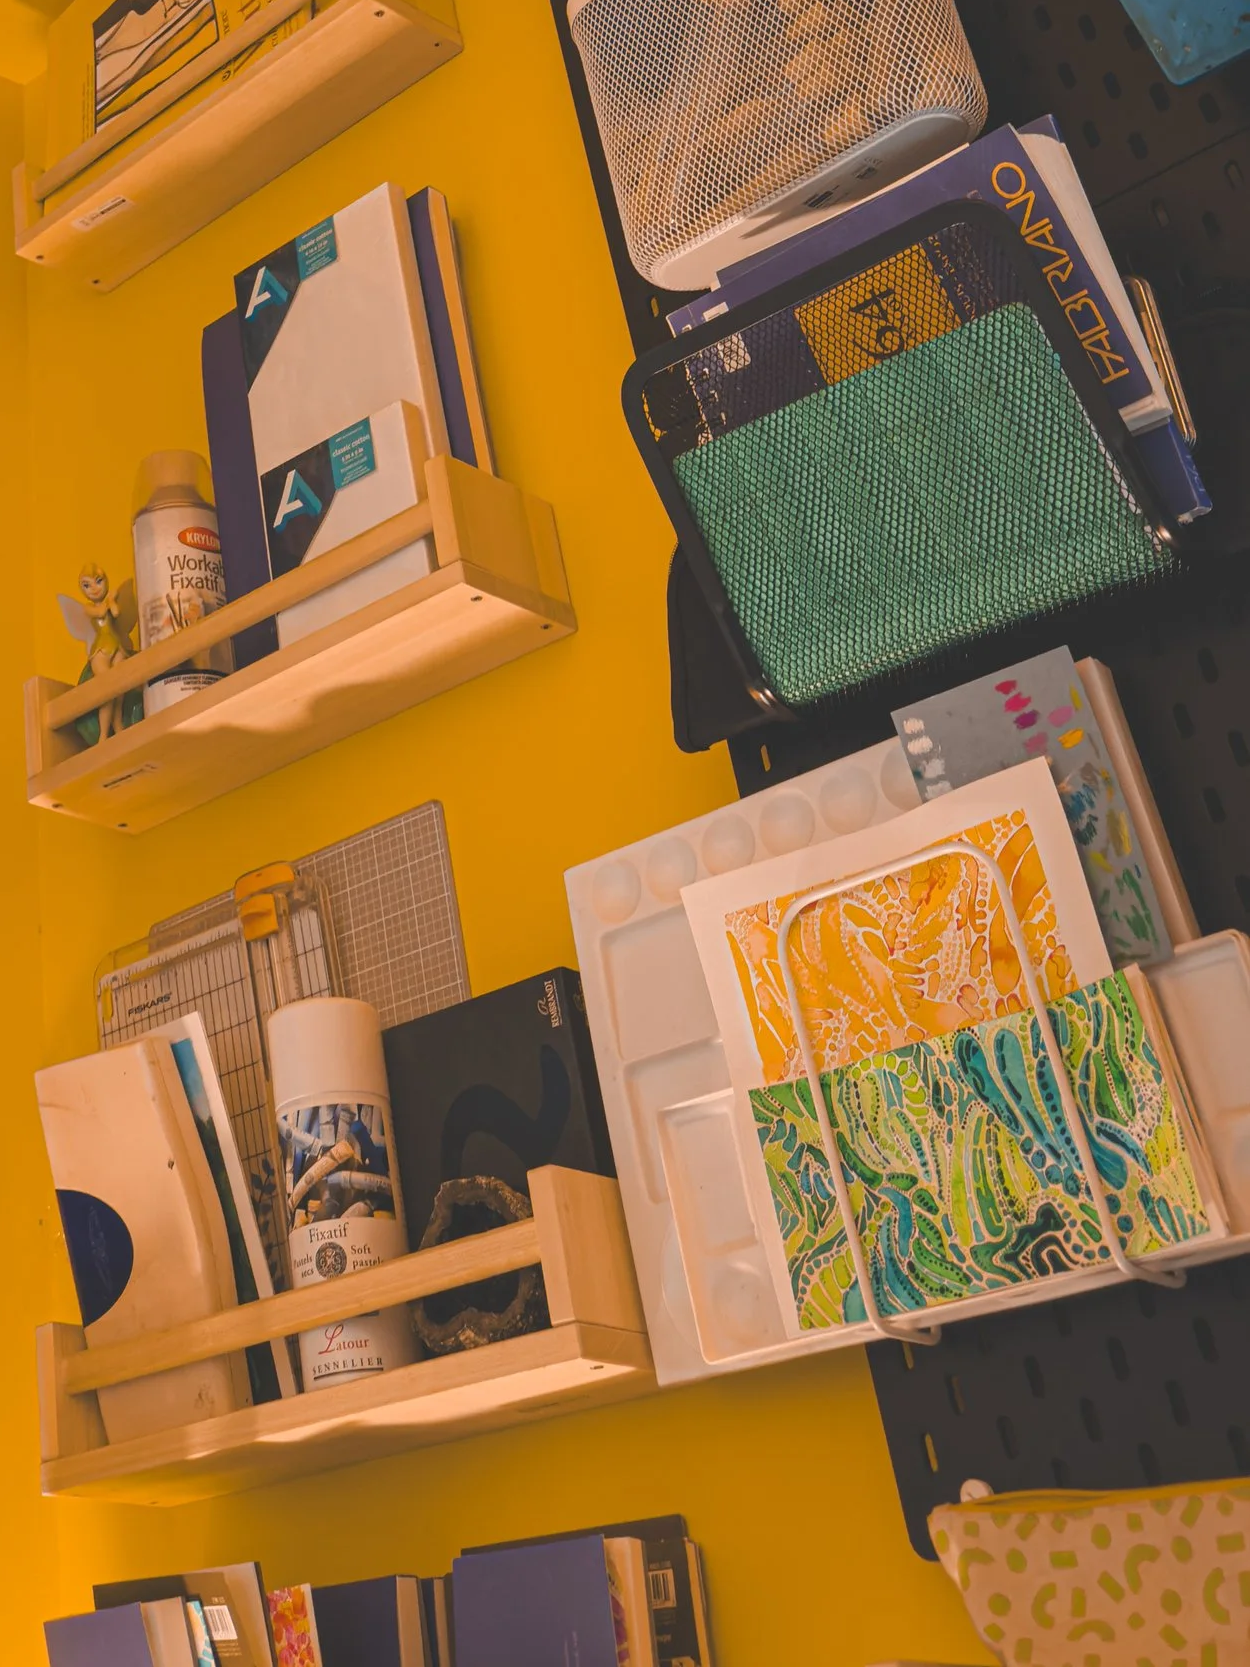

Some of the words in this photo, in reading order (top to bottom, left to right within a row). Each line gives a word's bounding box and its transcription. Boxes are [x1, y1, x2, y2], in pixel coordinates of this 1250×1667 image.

[991, 161, 1130, 384] FABRIANO
[167, 554, 225, 578] Workab
[170, 572, 219, 592] Fixatif
[128, 994, 171, 1017] FISKARS
[544, 980, 559, 1028] REMBRANDT
[308, 1222, 350, 1244] Fixatif
[350, 1245, 371, 1256] Soft
[352, 1255, 384, 1270] pastel
[318, 1323, 370, 1355] Latour
[312, 1356, 383, 1377] SENNELIER
